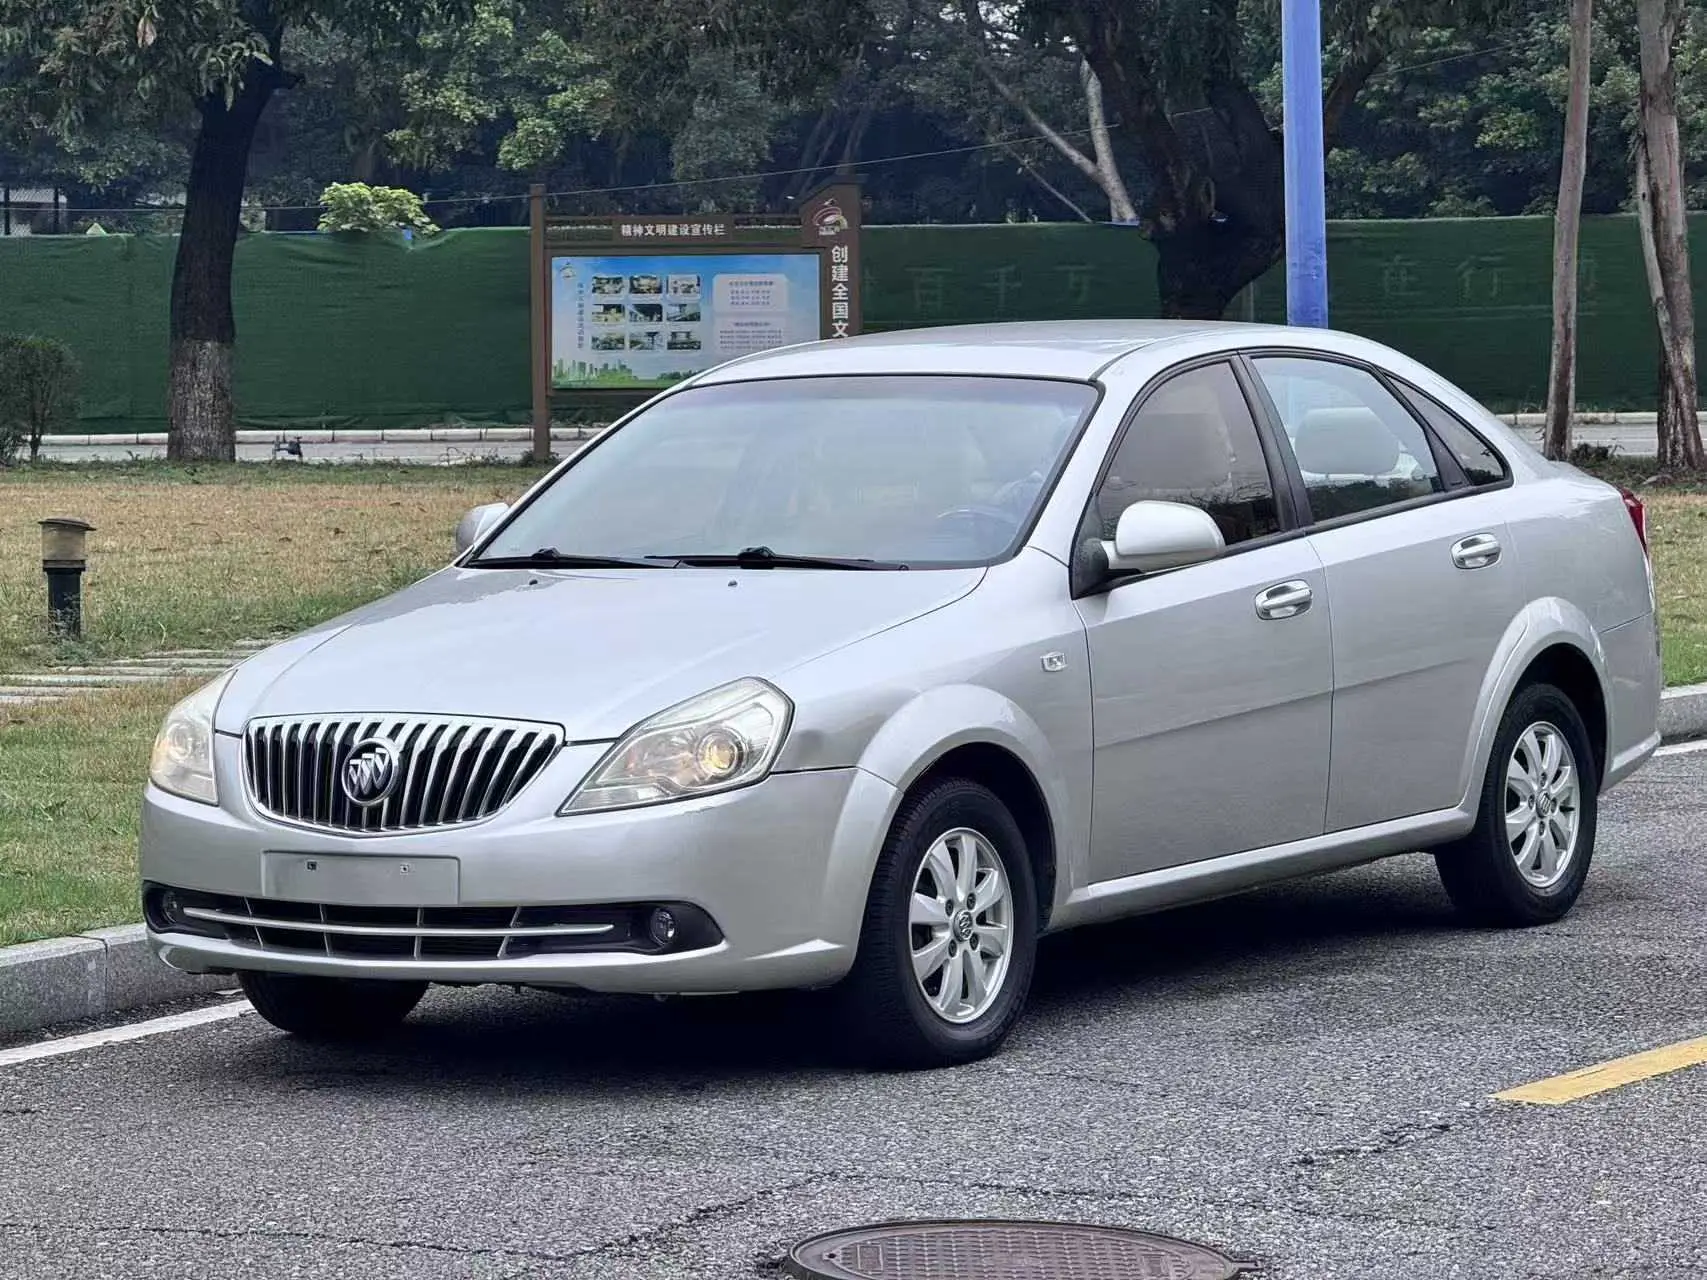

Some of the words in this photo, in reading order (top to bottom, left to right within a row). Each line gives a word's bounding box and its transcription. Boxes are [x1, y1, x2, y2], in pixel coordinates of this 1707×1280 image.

[621, 223, 727, 237] 精神文明建设宣传栏
[831, 245, 849, 338] 创建全国文
